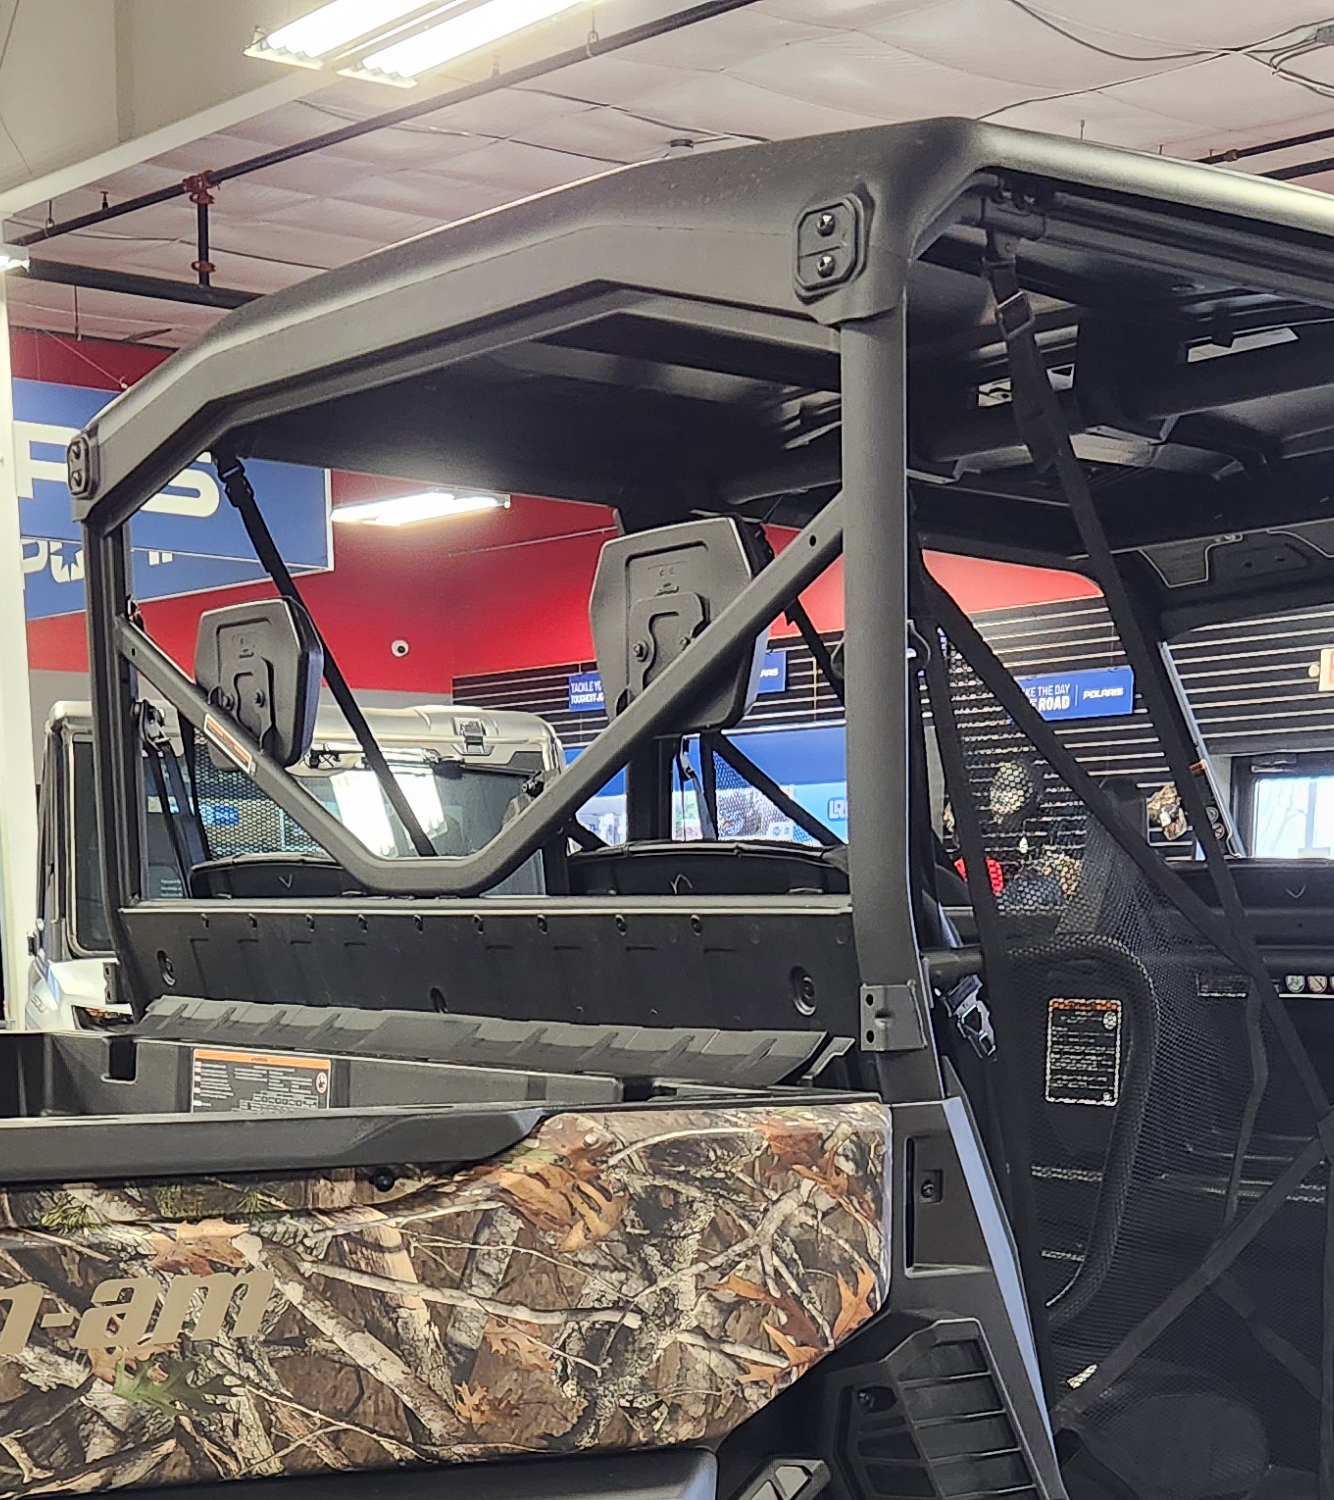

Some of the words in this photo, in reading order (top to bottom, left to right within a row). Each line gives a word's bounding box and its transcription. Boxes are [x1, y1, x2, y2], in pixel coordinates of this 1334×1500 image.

[1038, 685, 1053, 696] THE
[1055, 683, 1071, 695] DAY
[1083, 687, 1124, 700] POLARIS
[1038, 695, 1071, 712] ROAD
